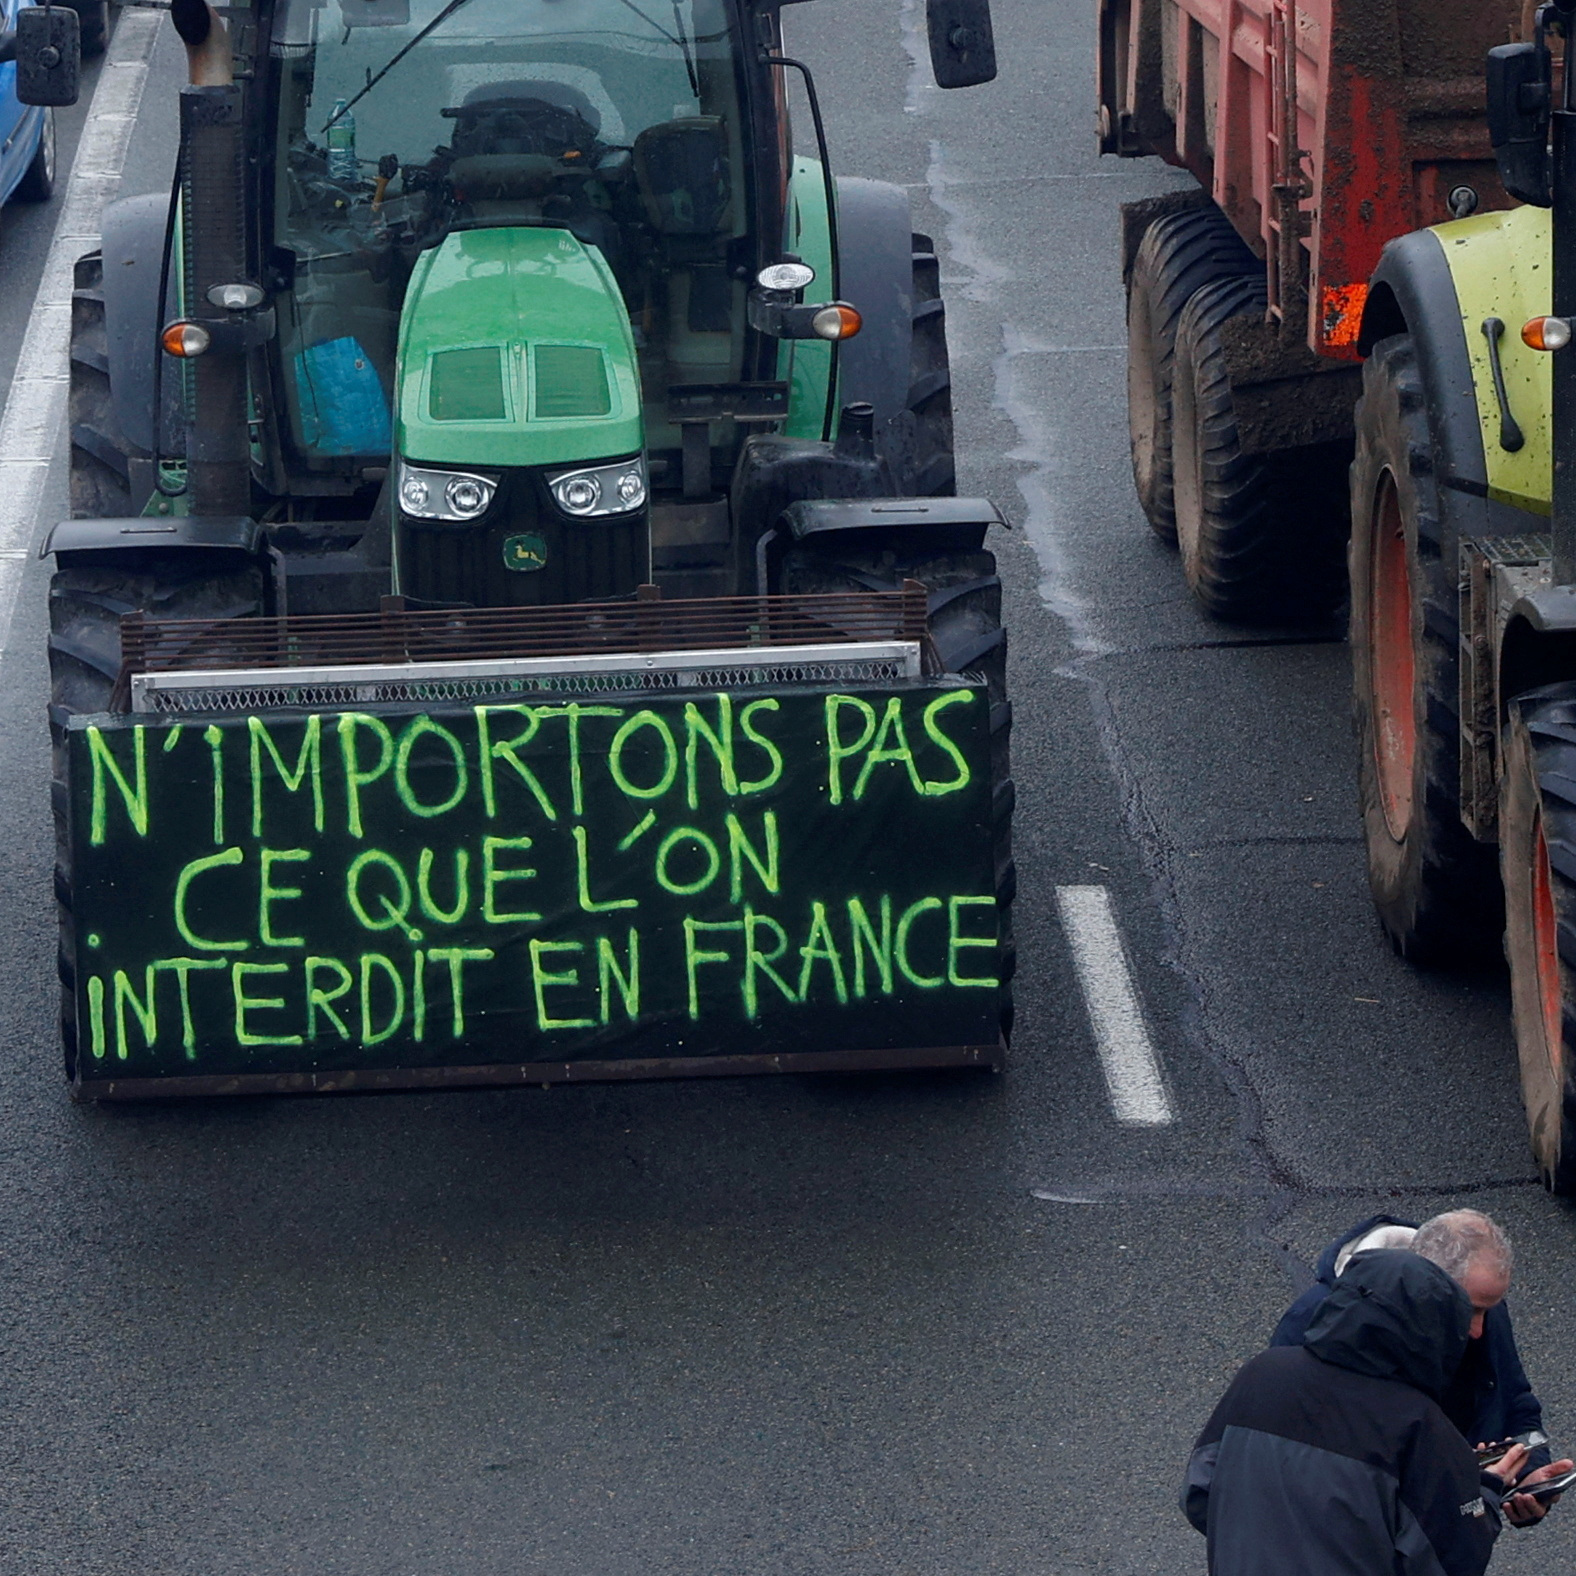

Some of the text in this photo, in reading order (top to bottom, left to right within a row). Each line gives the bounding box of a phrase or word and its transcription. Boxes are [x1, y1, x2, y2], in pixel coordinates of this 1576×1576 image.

[85, 688, 976, 846] N'IMPORTONS PAS
[174, 810, 780, 952] CE QUE L'ON
[529, 928, 640, 1031] EN
[682, 895, 1000, 1018] FRANCE
